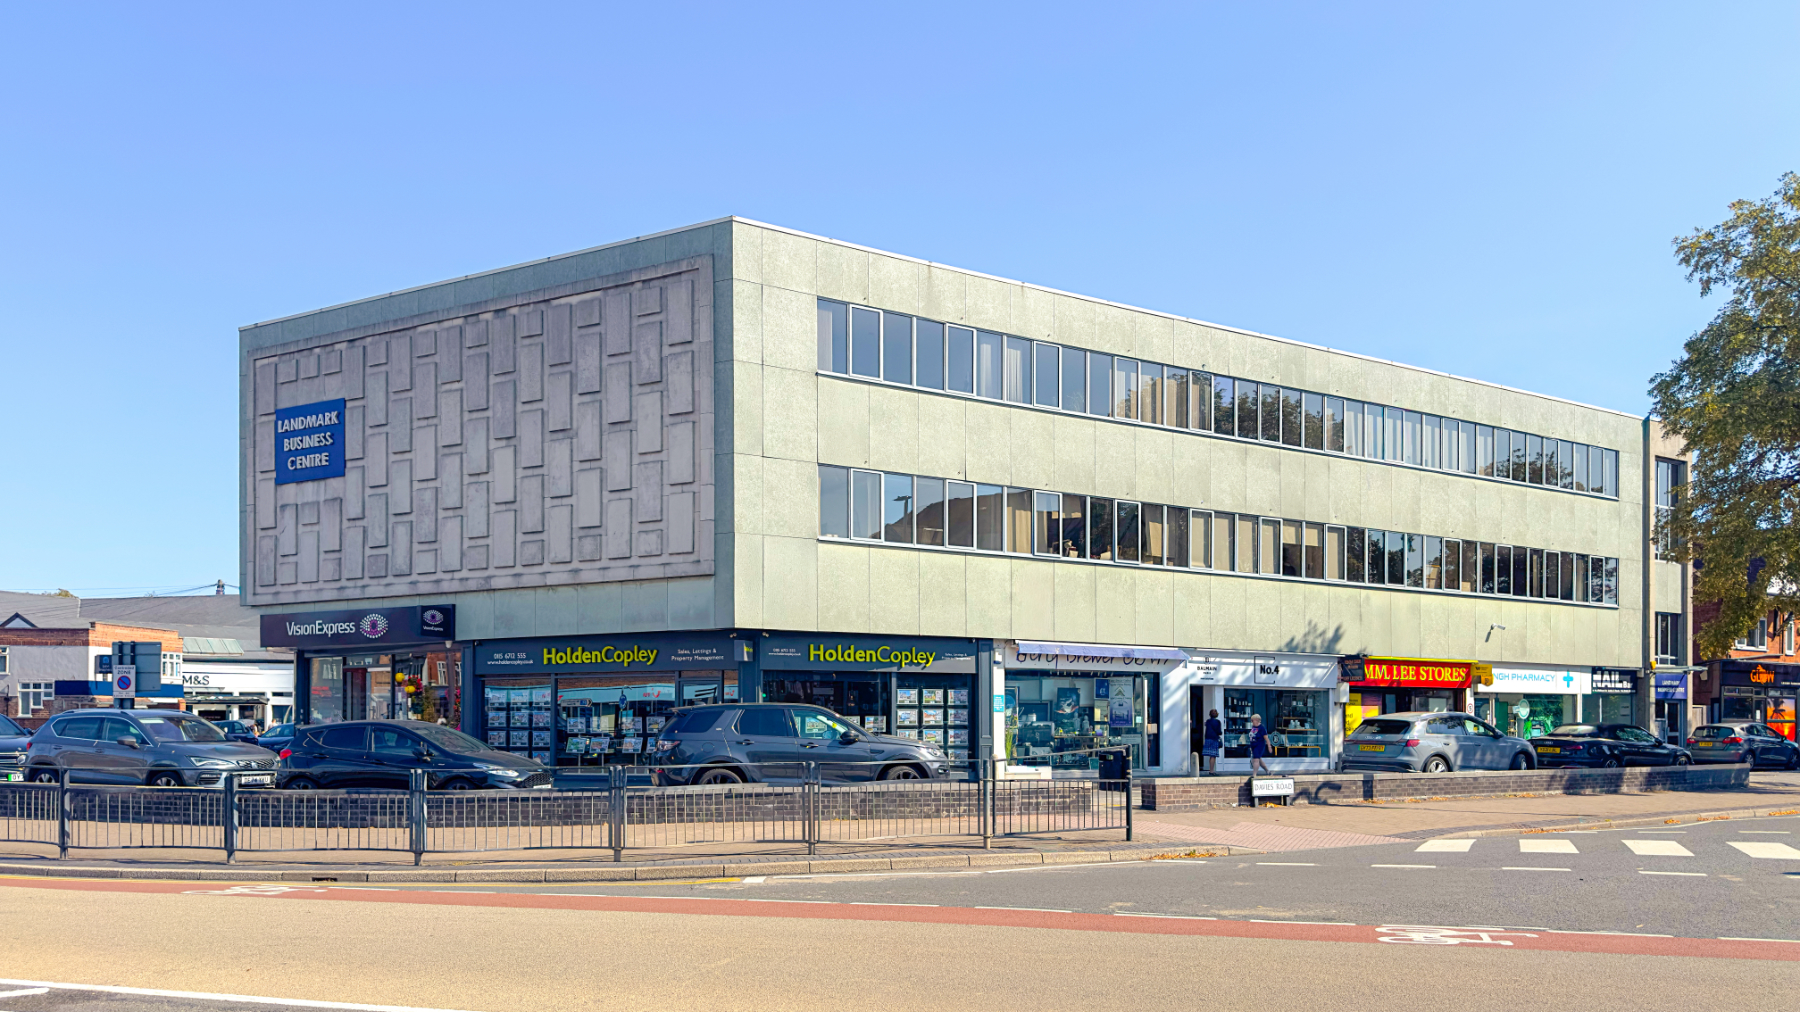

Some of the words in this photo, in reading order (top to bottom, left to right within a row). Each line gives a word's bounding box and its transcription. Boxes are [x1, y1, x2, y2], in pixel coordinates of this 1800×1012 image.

[277, 411, 339, 433] LANDMARK
[283, 432, 333, 452] BUSINESS
[287, 452, 329, 470] CENTRE
[286, 620, 356, 638] VisionExpress
[543, 645, 658, 667] HoldenCopley
[808, 643, 936, 668] HoldenCopley
[1259, 664, 1279, 675] No.4
[1419, 665, 1466, 682] STORES
[1511, 673, 1555, 682] PHARMACY
[182, 674, 210, 686] M&S
[1592, 670, 1623, 688] NAIL
[1255, 783, 1274, 791] DAVIES
